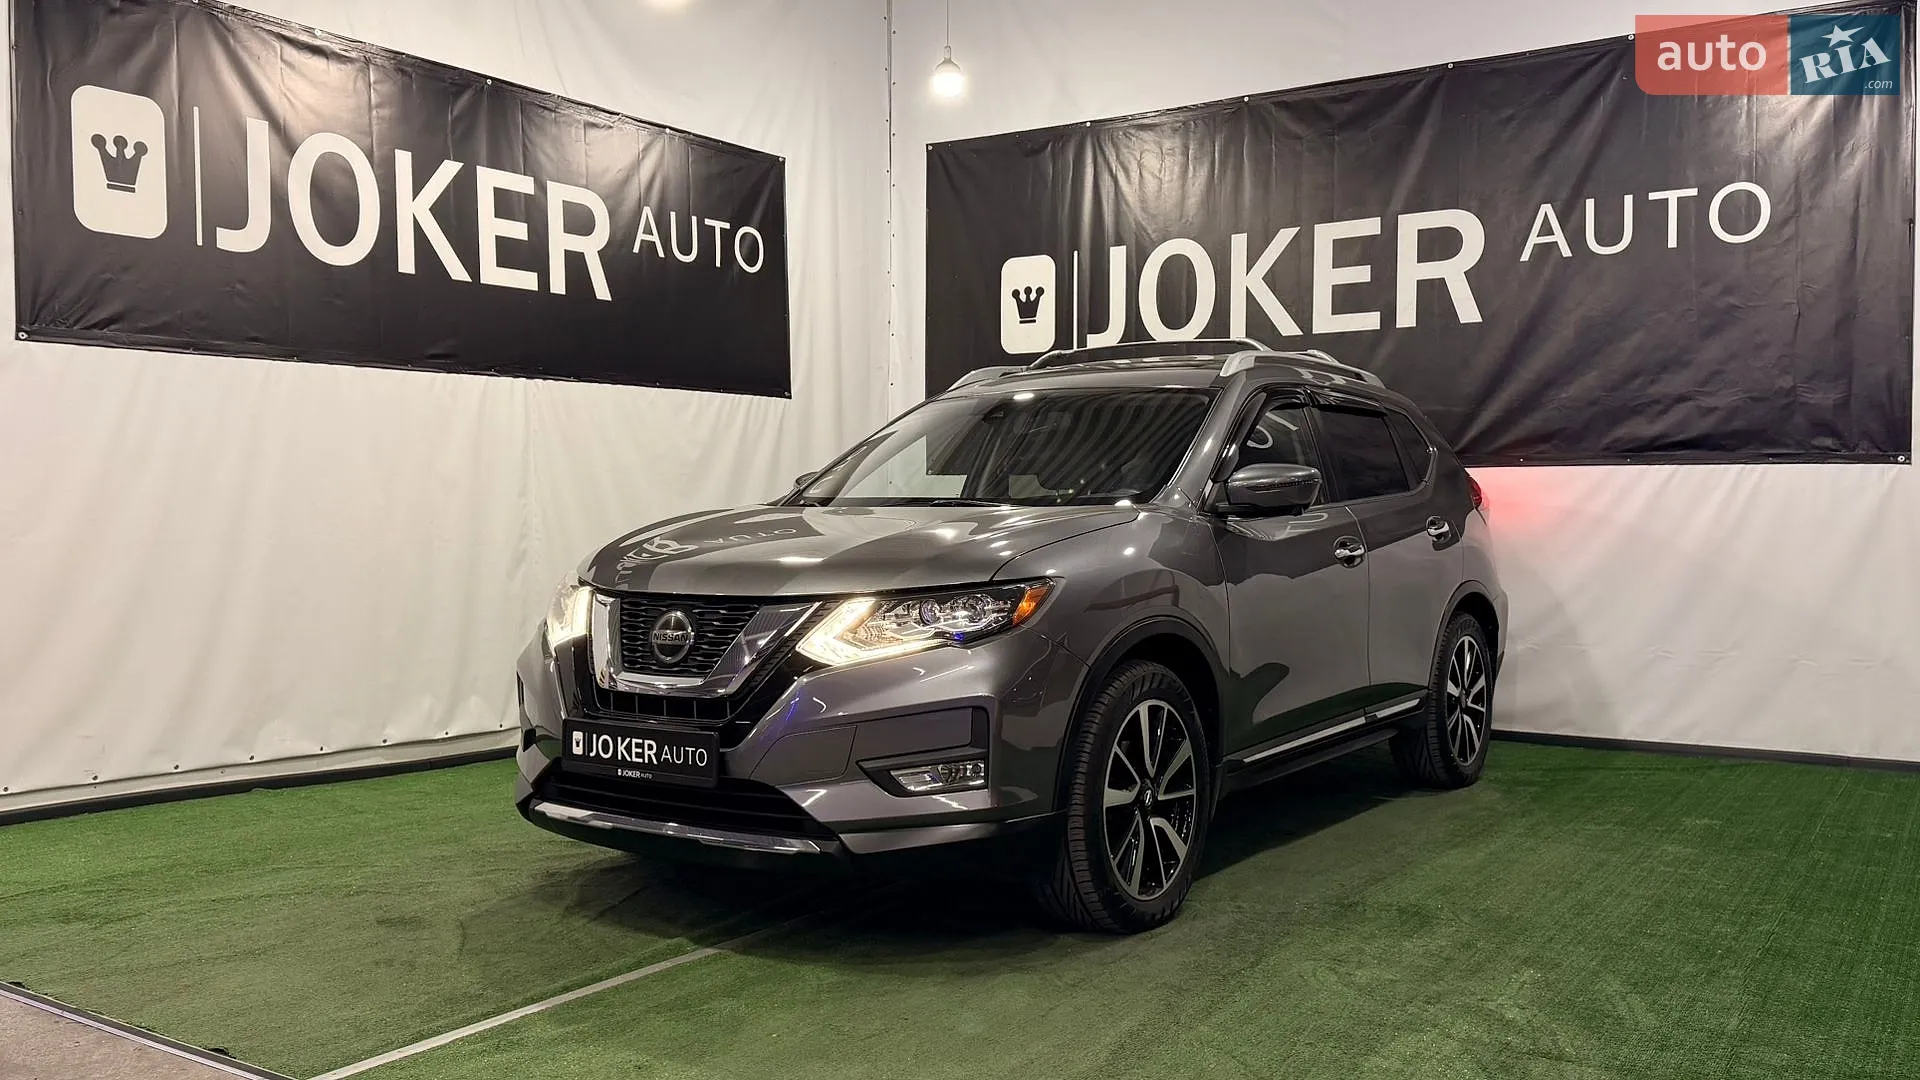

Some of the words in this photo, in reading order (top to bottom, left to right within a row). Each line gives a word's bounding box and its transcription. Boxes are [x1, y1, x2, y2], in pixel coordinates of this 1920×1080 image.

[216, 117, 612, 302] JOKER
[632, 206, 764, 274] AUTO
[1086, 208, 1485, 349] JOKER
[1520, 181, 1772, 262] AUTO
[653, 632, 689, 642] NISSAN
[661, 745, 708, 767] AUTO
[622, 769, 641, 779] JOKER
